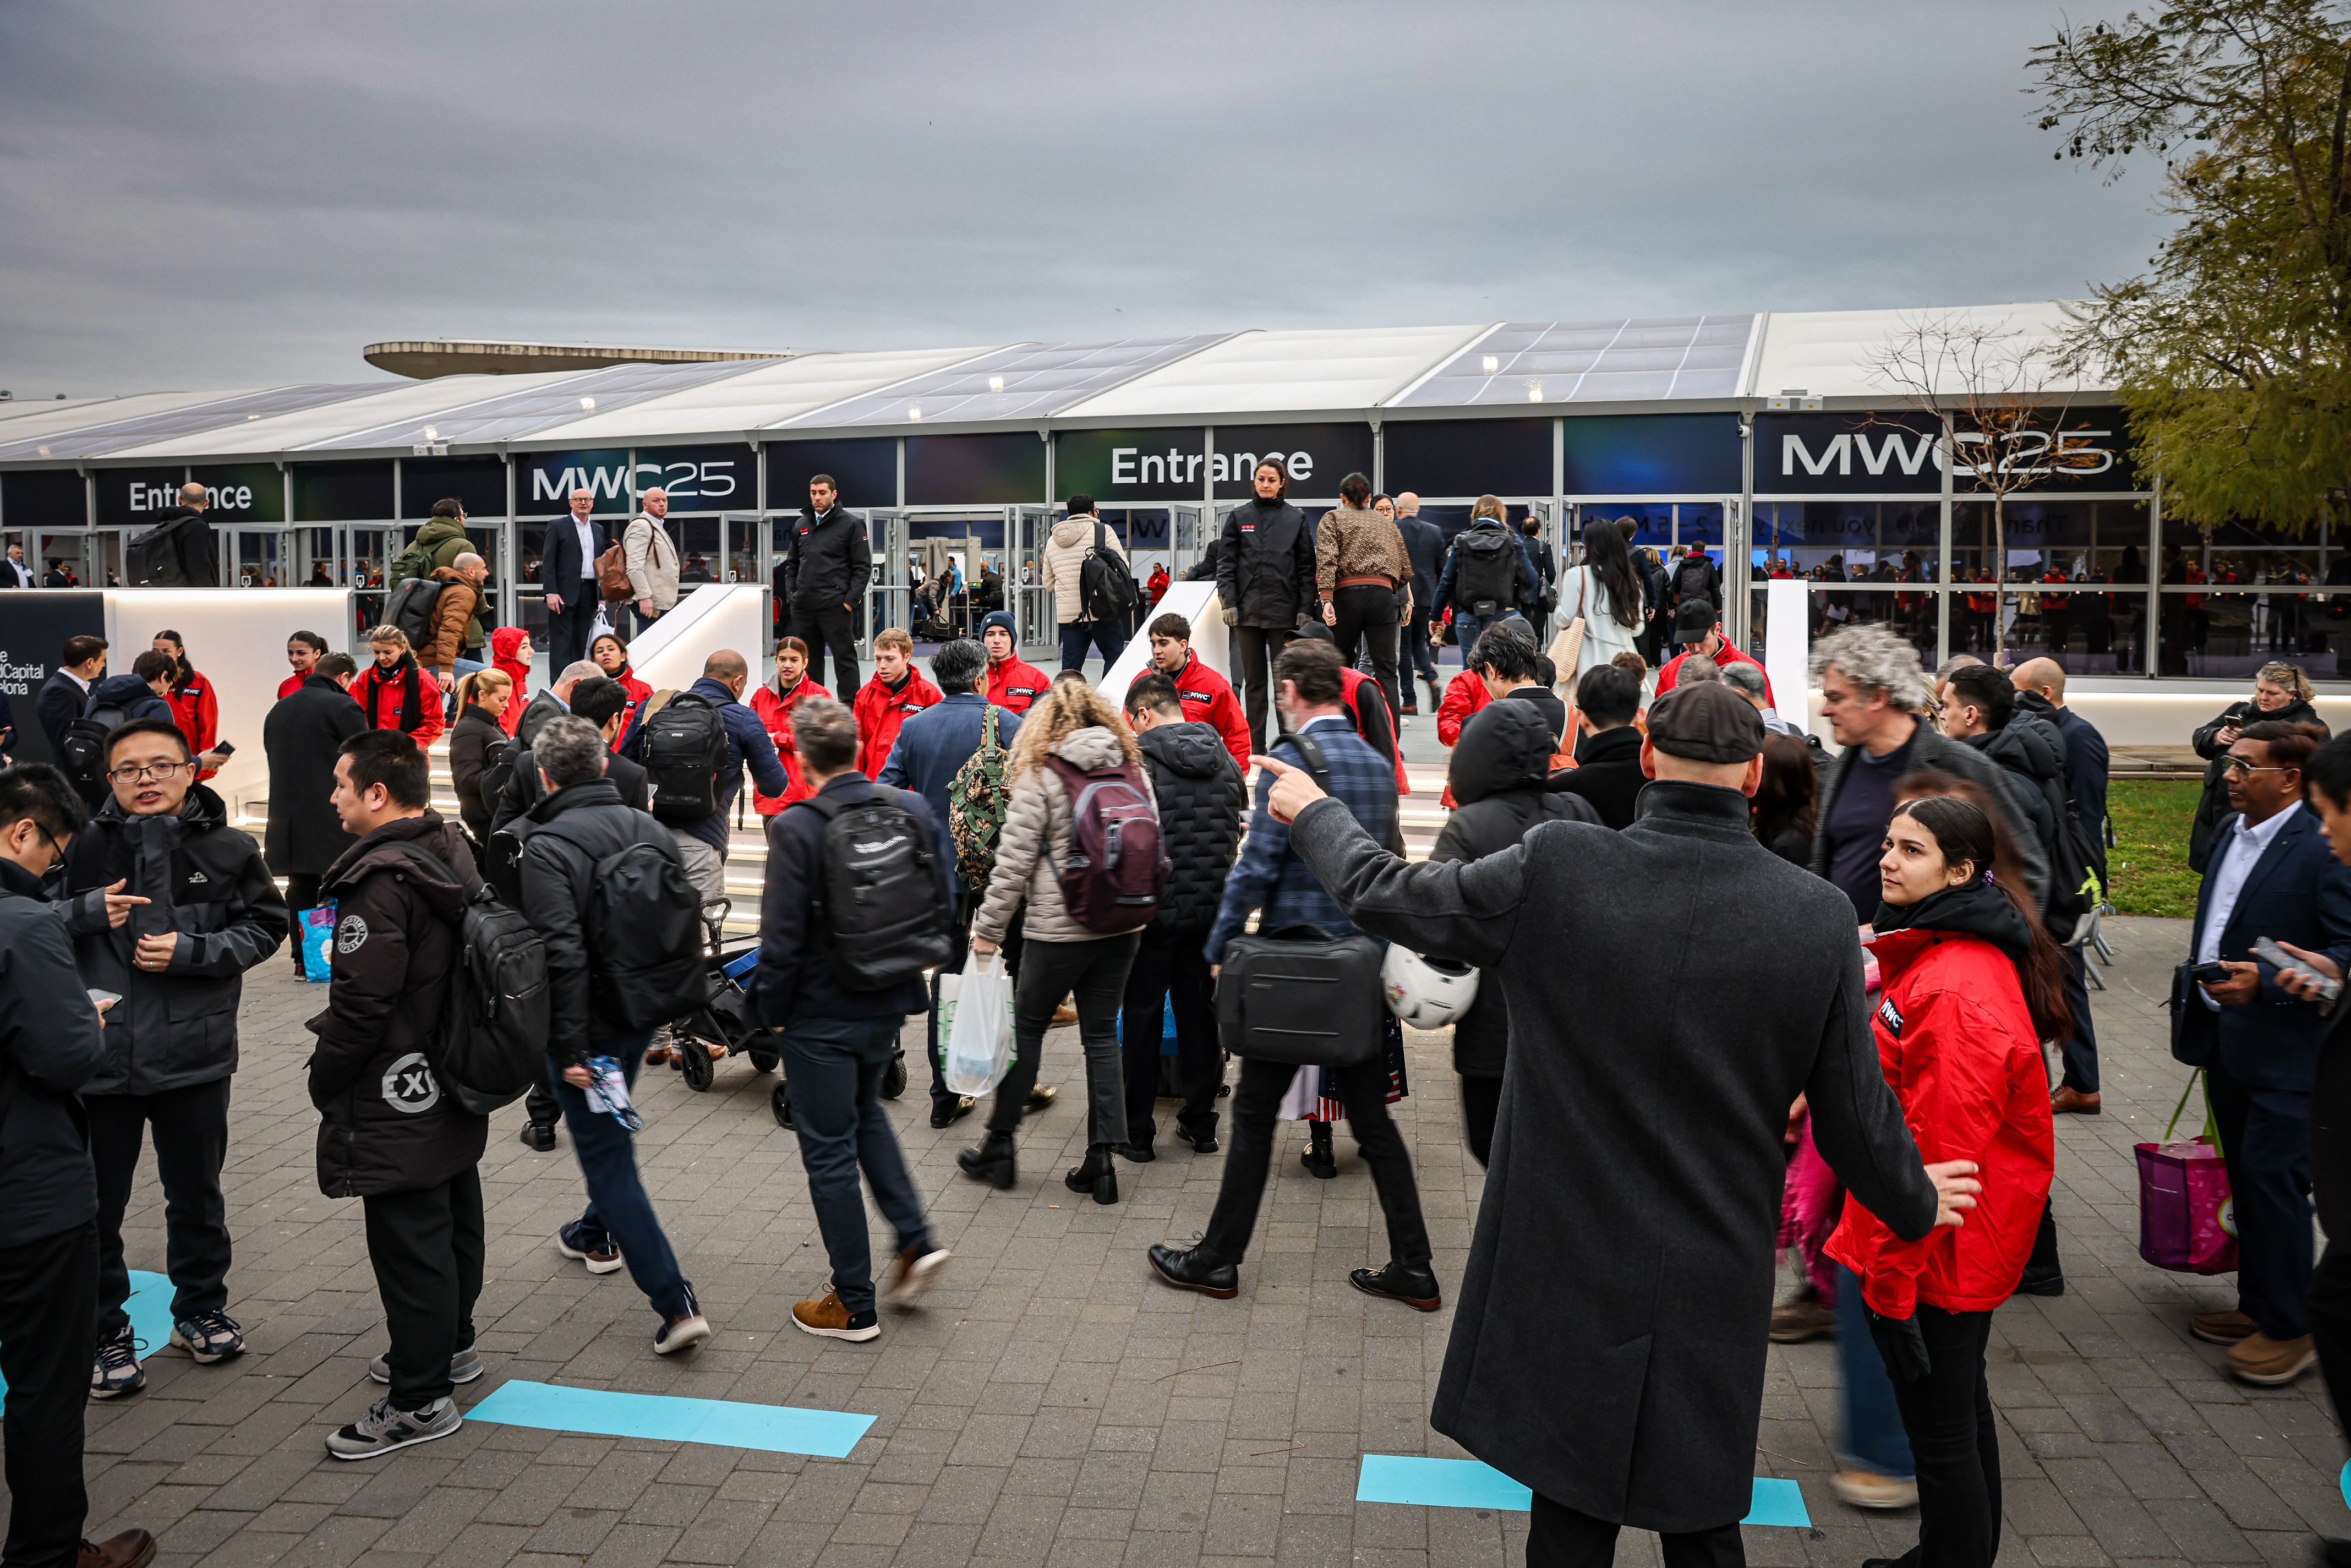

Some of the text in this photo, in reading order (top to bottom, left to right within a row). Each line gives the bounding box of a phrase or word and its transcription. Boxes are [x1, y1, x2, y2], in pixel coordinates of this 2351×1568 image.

[1782, 430, 2113, 476] MWC25
[533, 461, 736, 500] MWC25
[130, 482, 252, 511] Entnce
[1190, 691, 1211, 700] MWC
[1878, 998, 1903, 1028] MWC
